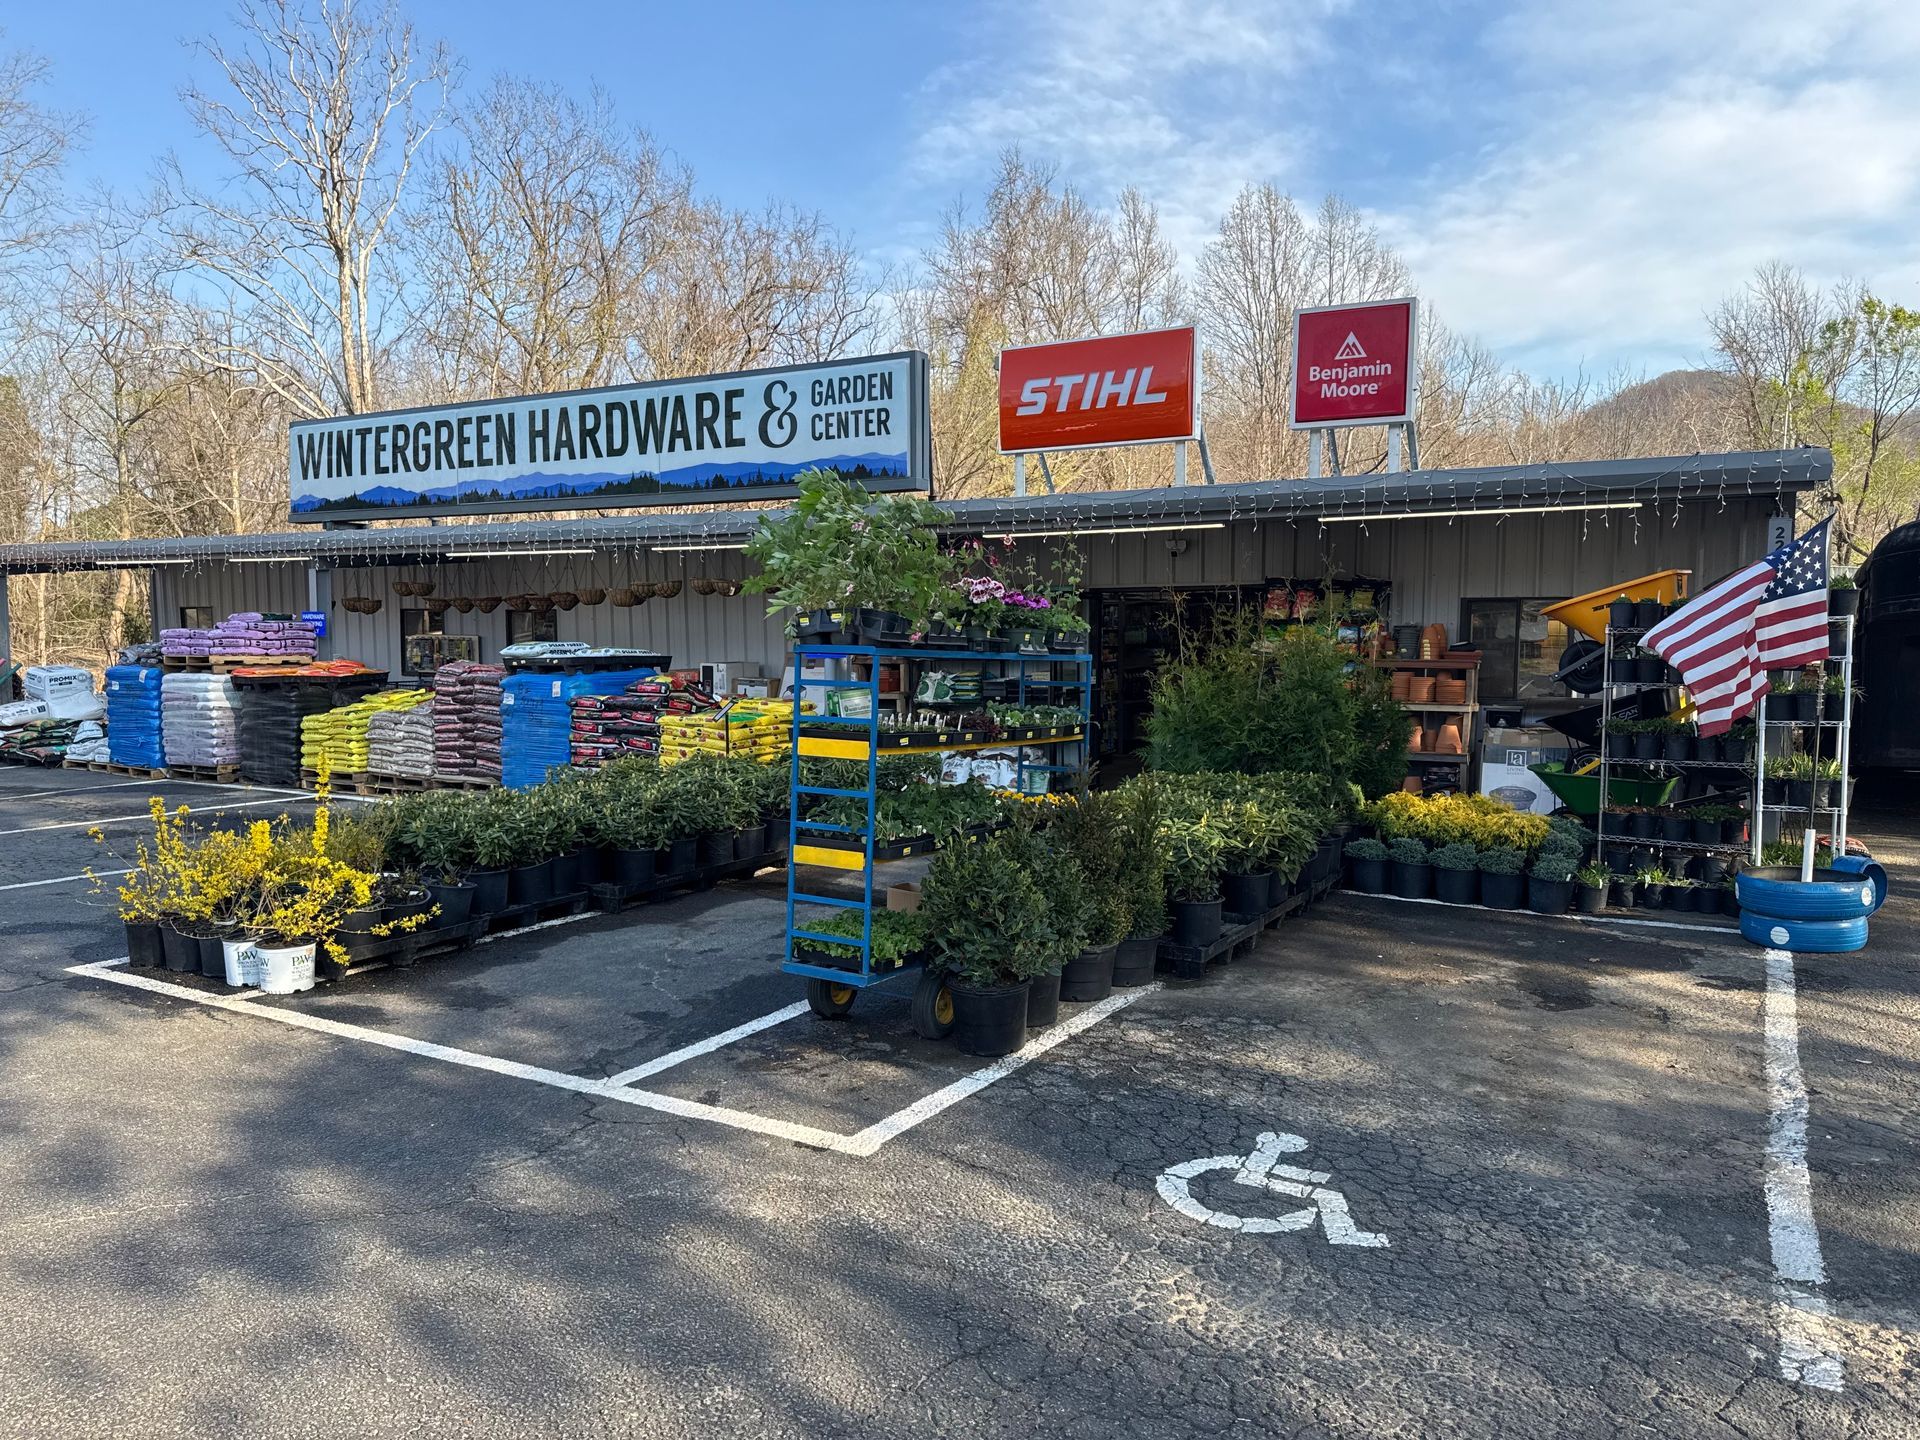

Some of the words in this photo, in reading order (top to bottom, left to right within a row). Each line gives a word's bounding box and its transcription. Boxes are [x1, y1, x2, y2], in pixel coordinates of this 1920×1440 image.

[1309, 360, 1392, 382] Benjamin
[810, 371, 893, 407] GARDEN
[1016, 365, 1168, 417] STIHL
[1320, 382, 1379, 399] Moore
[297, 411, 516, 481] WINTERGREEN
[528, 388, 746, 462] HARDWARE
[758, 379, 798, 449] &
[810, 407, 891, 441] CENTER
